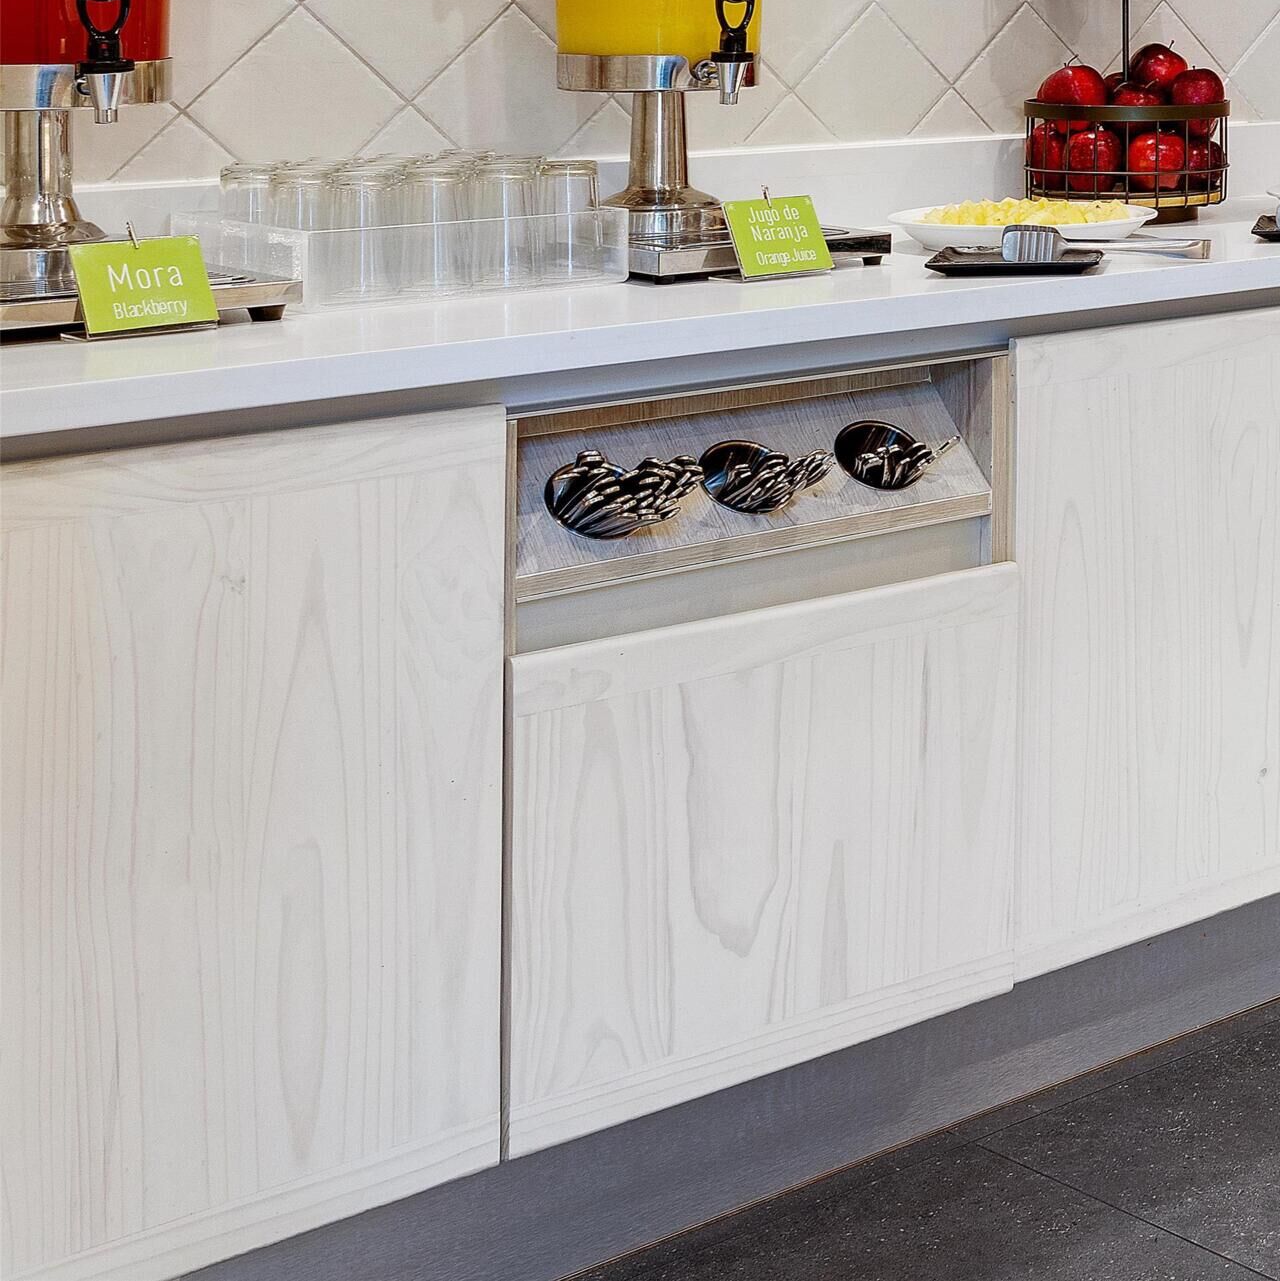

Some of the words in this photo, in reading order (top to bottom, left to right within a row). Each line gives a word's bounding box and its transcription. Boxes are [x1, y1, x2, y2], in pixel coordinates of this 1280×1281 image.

[748, 207, 780, 226] Jugo
[783, 205, 800, 220] de
[750, 223, 809, 243] Naranja
[756, 251, 791, 267] Orange
[792, 248, 817, 262] Juice
[107, 263, 184, 293] Mora
[112, 298, 188, 320] Blackberry
